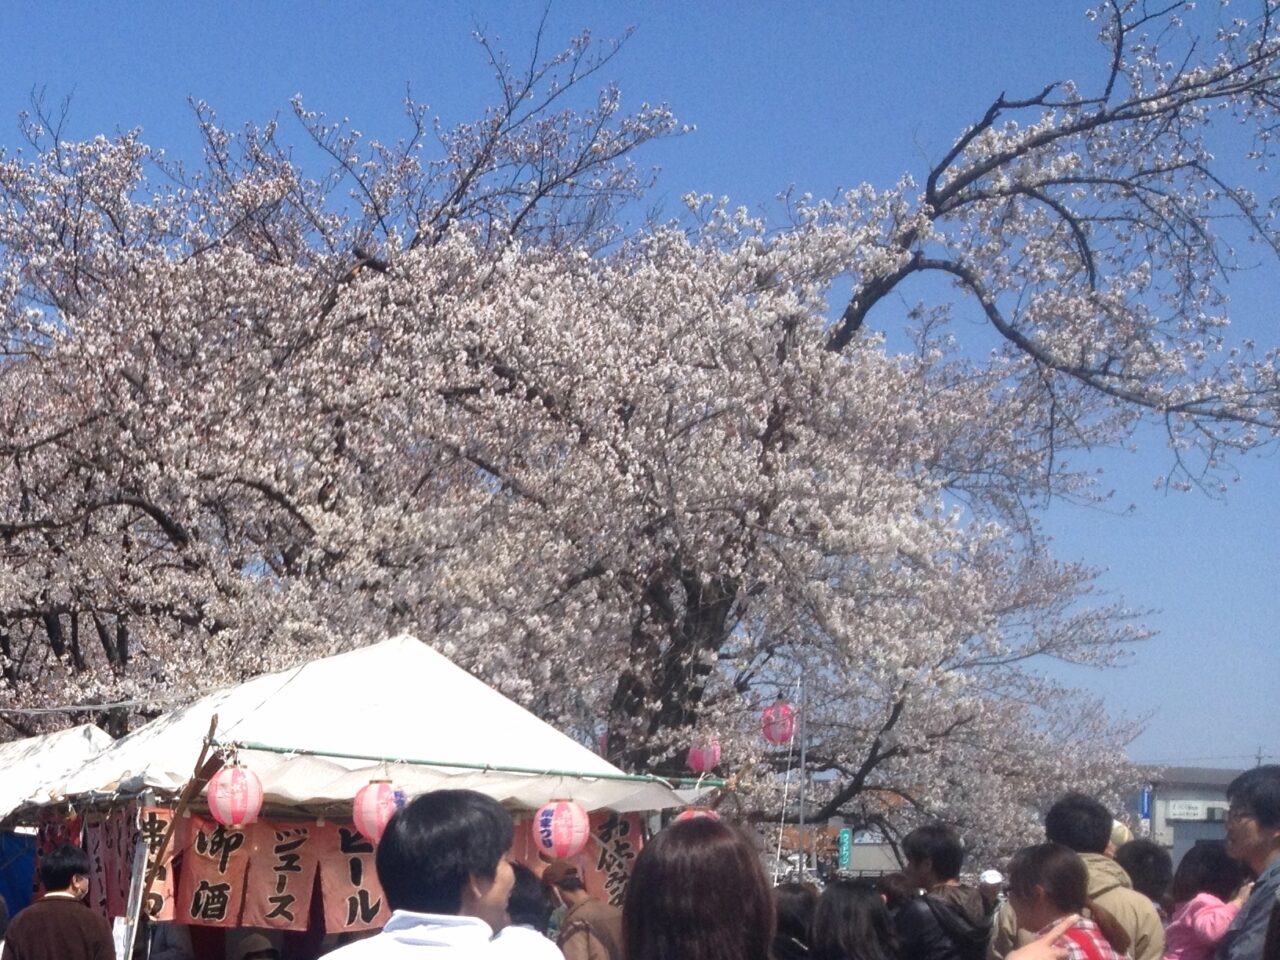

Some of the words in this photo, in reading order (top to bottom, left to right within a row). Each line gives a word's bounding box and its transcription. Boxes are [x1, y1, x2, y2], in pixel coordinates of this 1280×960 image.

[191, 826, 245, 921] 御酒
[266, 828, 308, 922] ジュース
